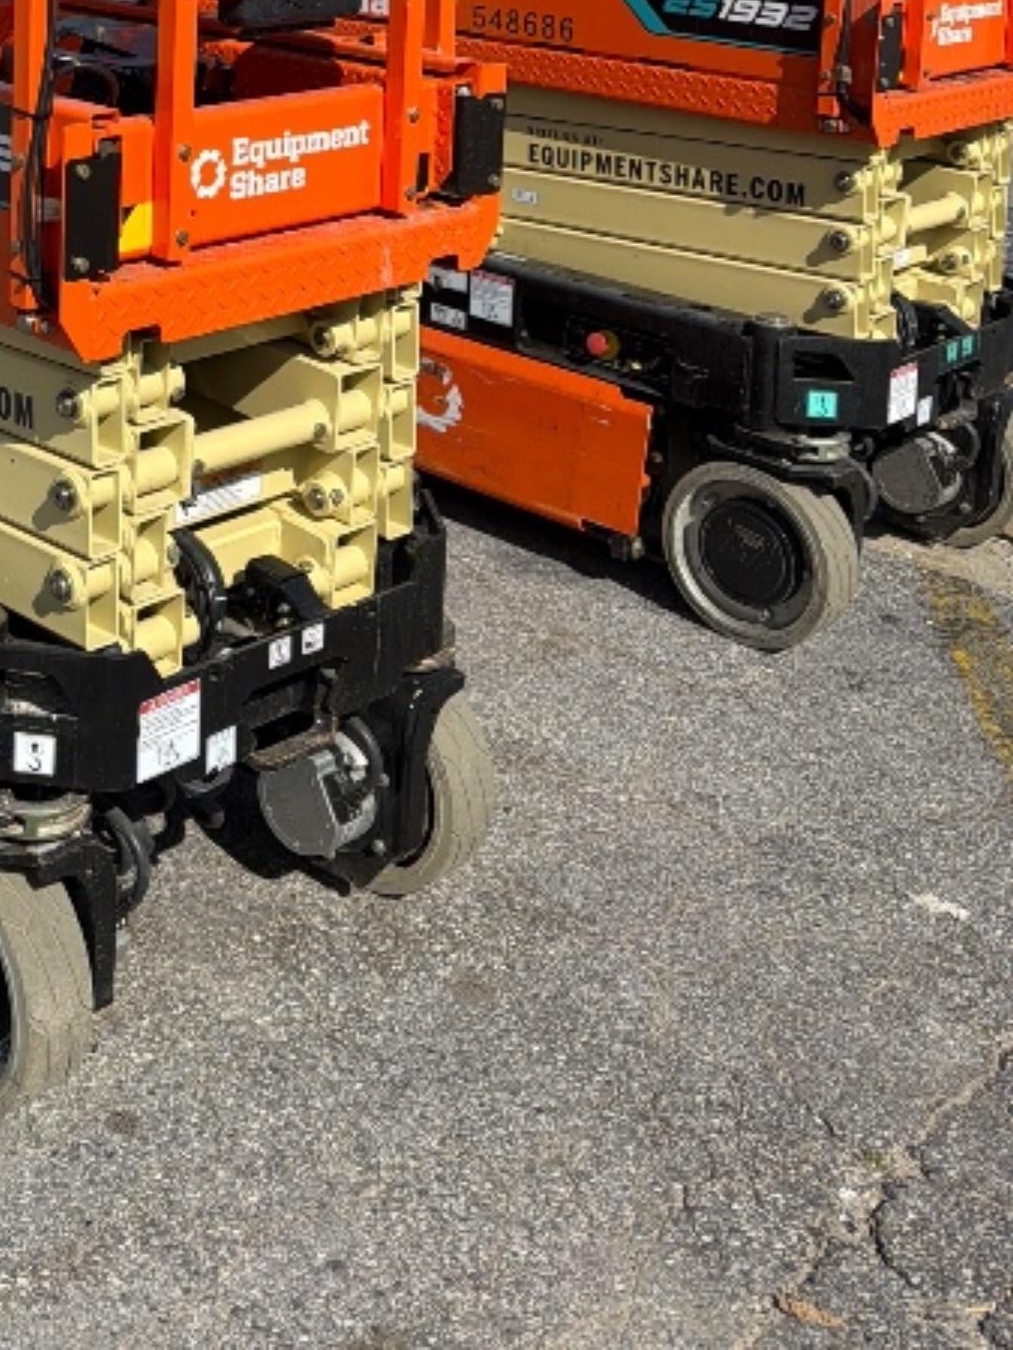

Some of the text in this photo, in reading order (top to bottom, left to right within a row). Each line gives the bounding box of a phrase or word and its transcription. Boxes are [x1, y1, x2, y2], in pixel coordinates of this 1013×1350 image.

[470, 5, 575, 43] 548686
[232, 120, 371, 168] Equipment
[229, 166, 306, 199] Share
[527, 143, 807, 208] EQUIPMENTSHARE.COM
